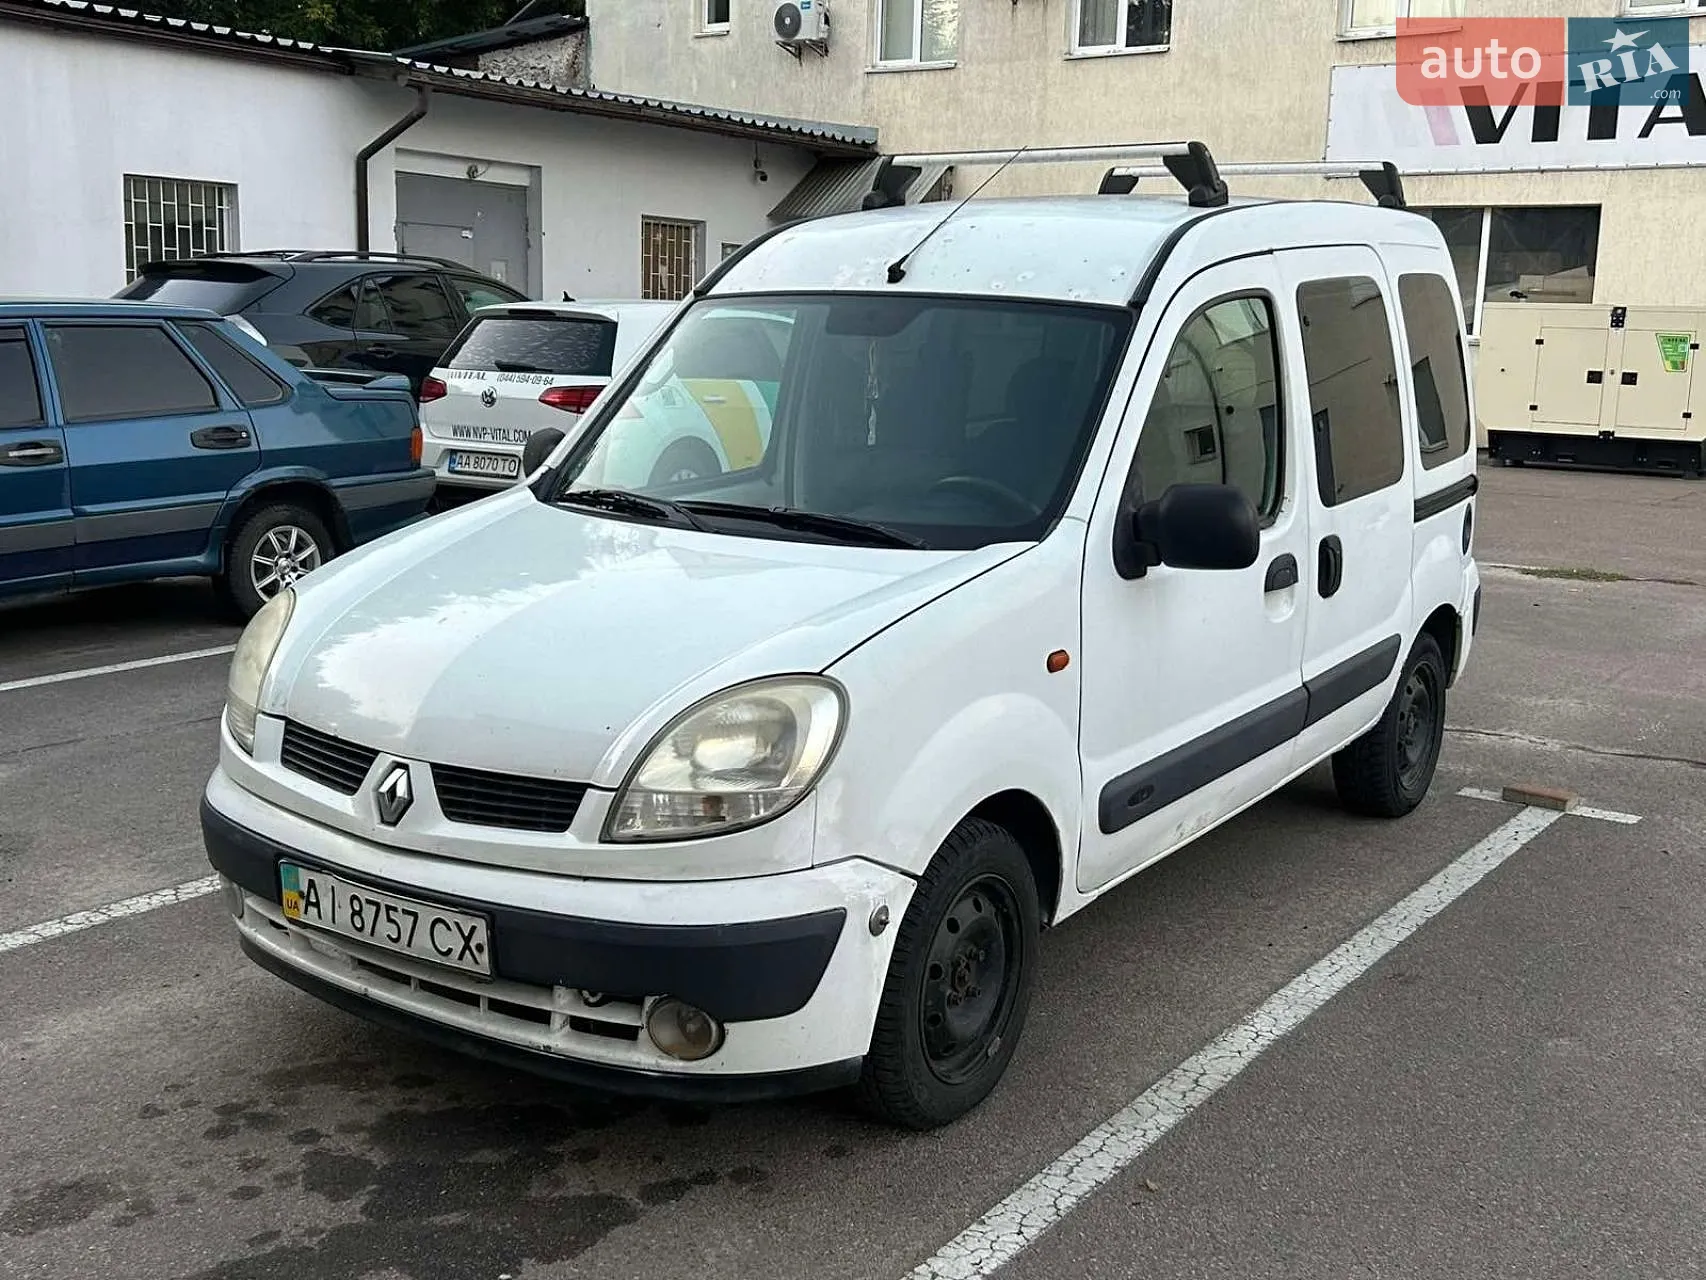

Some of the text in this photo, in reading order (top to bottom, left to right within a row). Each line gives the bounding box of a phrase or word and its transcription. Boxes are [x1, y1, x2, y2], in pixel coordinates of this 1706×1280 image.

[457, 454, 517, 473] AA 8070 TO
[286, 897, 299, 912] UA
[303, 878, 481, 965] AI 8757 CX
